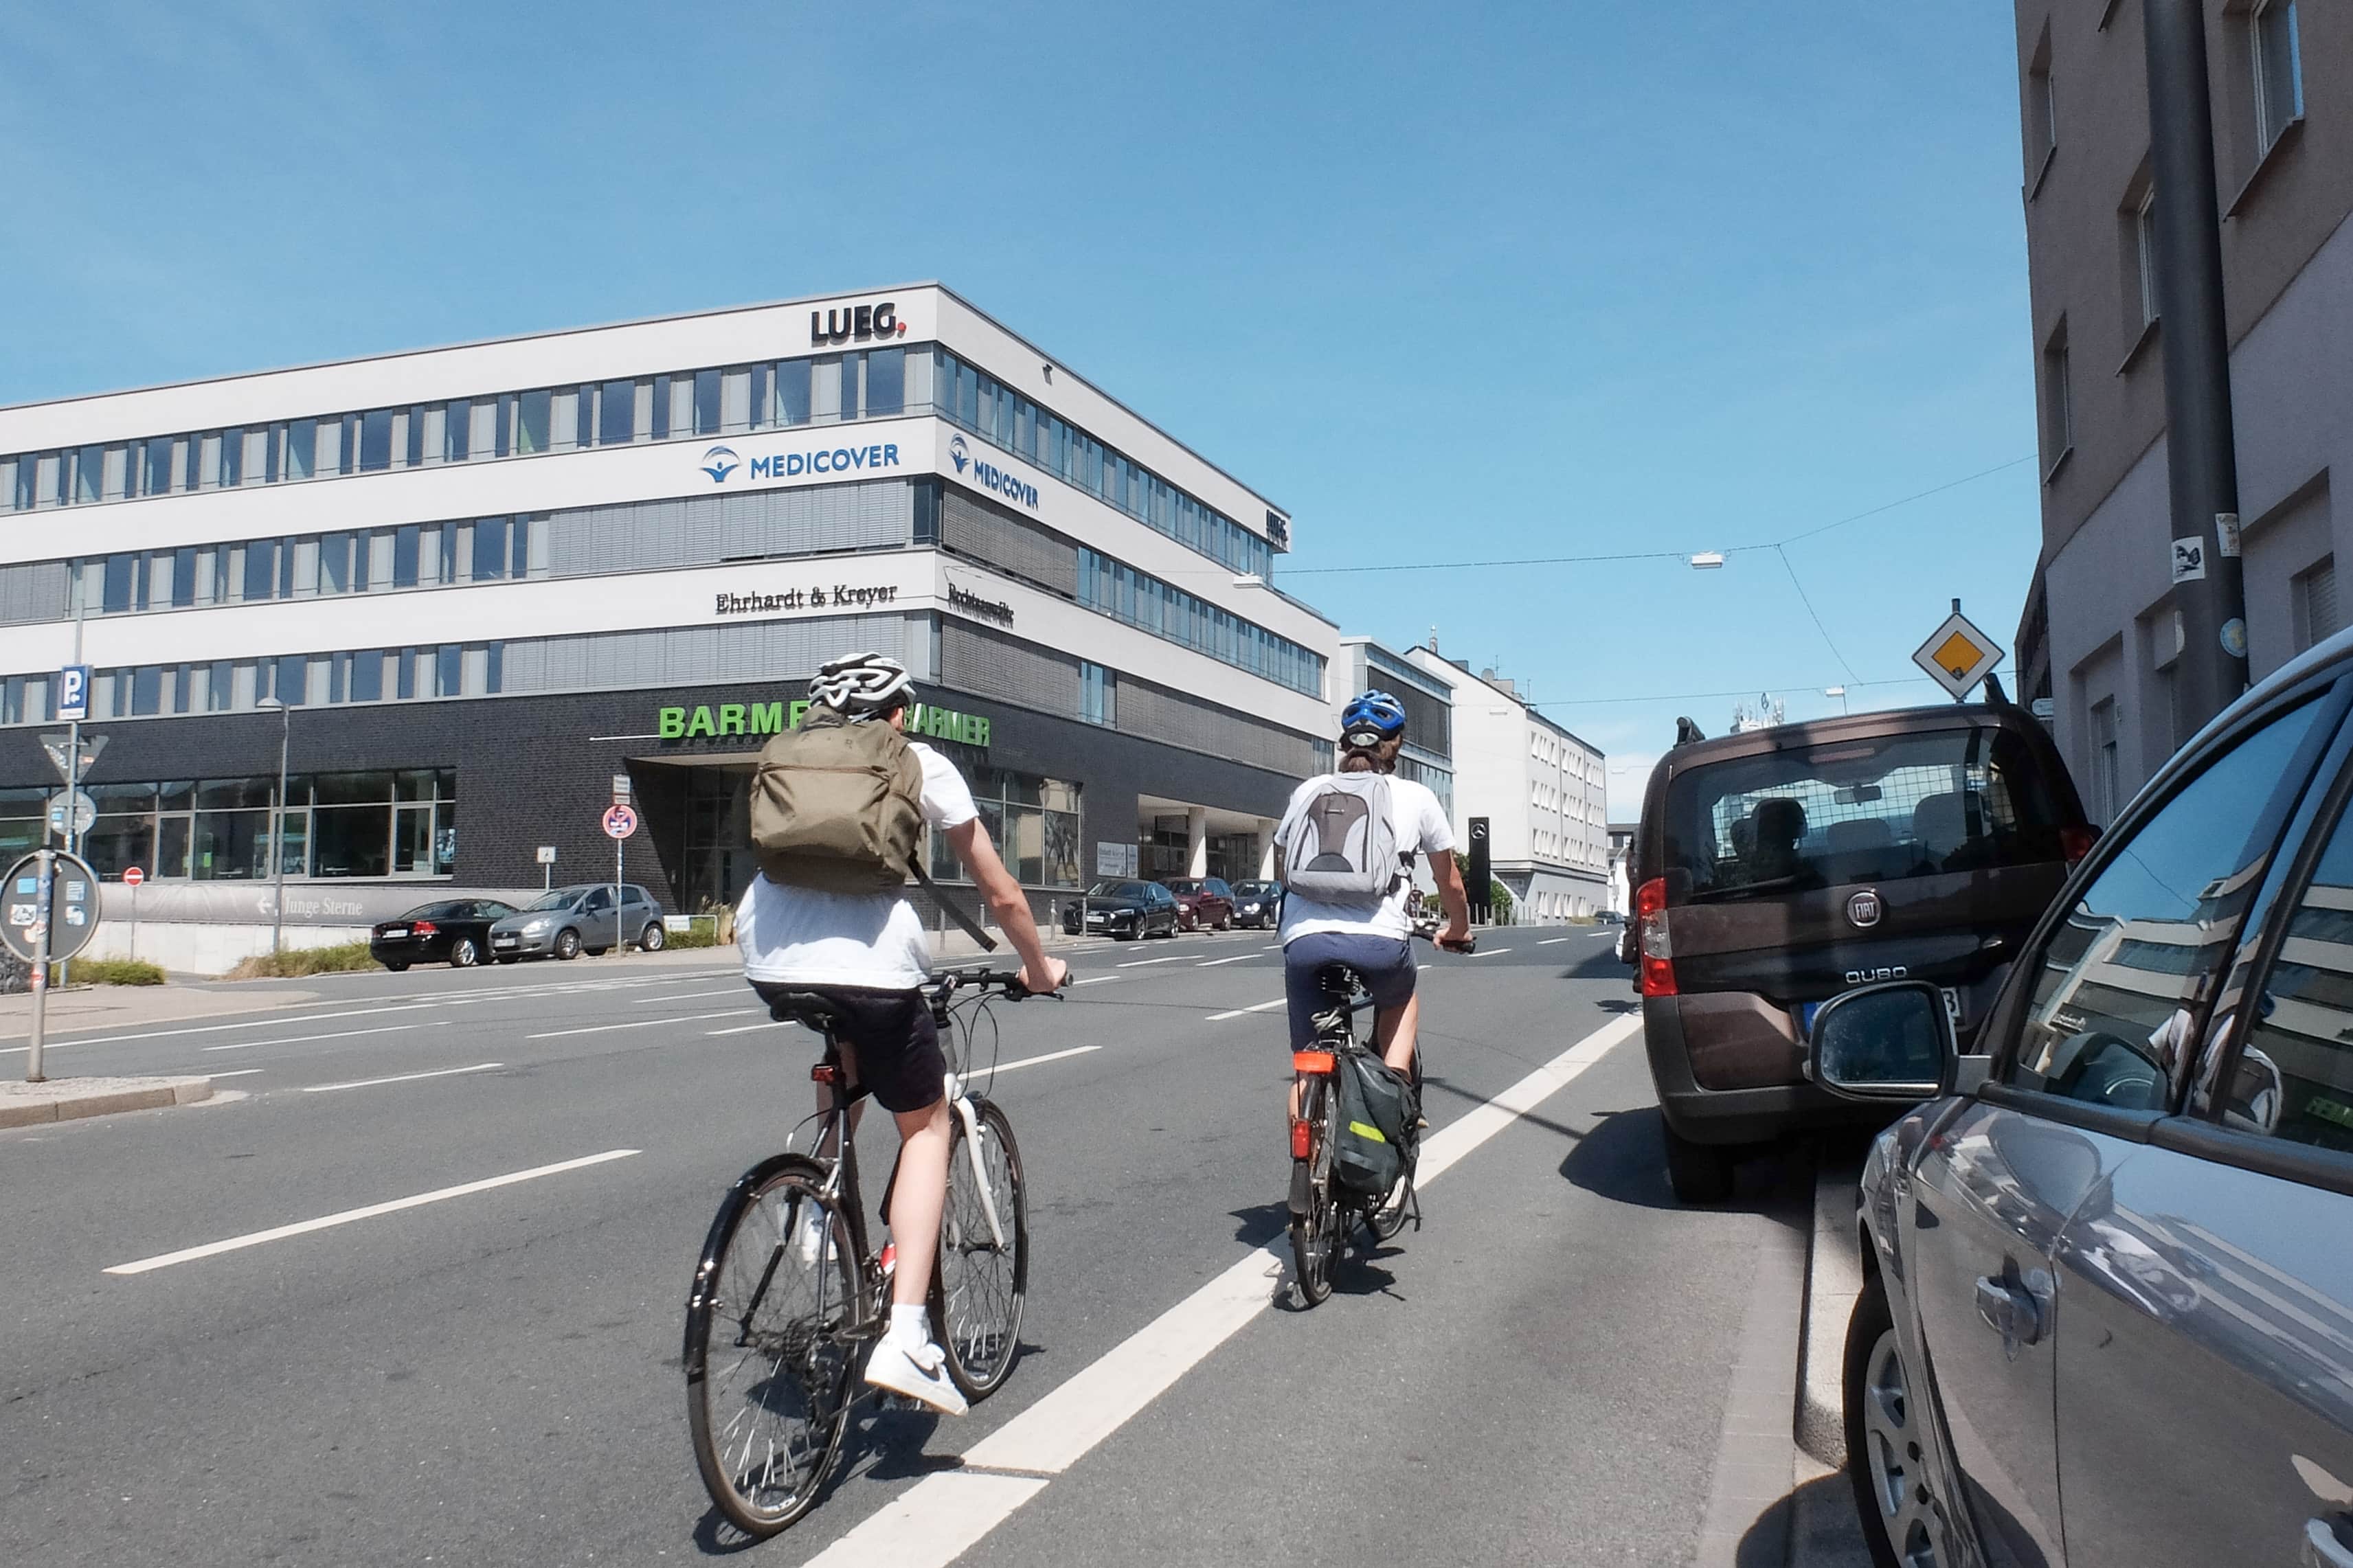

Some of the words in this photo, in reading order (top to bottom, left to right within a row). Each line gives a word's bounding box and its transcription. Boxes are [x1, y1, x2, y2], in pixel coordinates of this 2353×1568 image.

[751, 444, 899, 479] MEDICOVER
[974, 458, 1039, 511] MEDICOVER
[716, 588, 803, 613] Ehrhardt
[810, 587, 826, 605] &
[833, 584, 898, 609] Kreyer
[64, 670, 82, 705] P
[284, 896, 319, 918] Junge
[322, 896, 363, 916] Sterne
[1855, 902, 1875, 918] FIAT
[1845, 966, 1907, 984] QUBO
